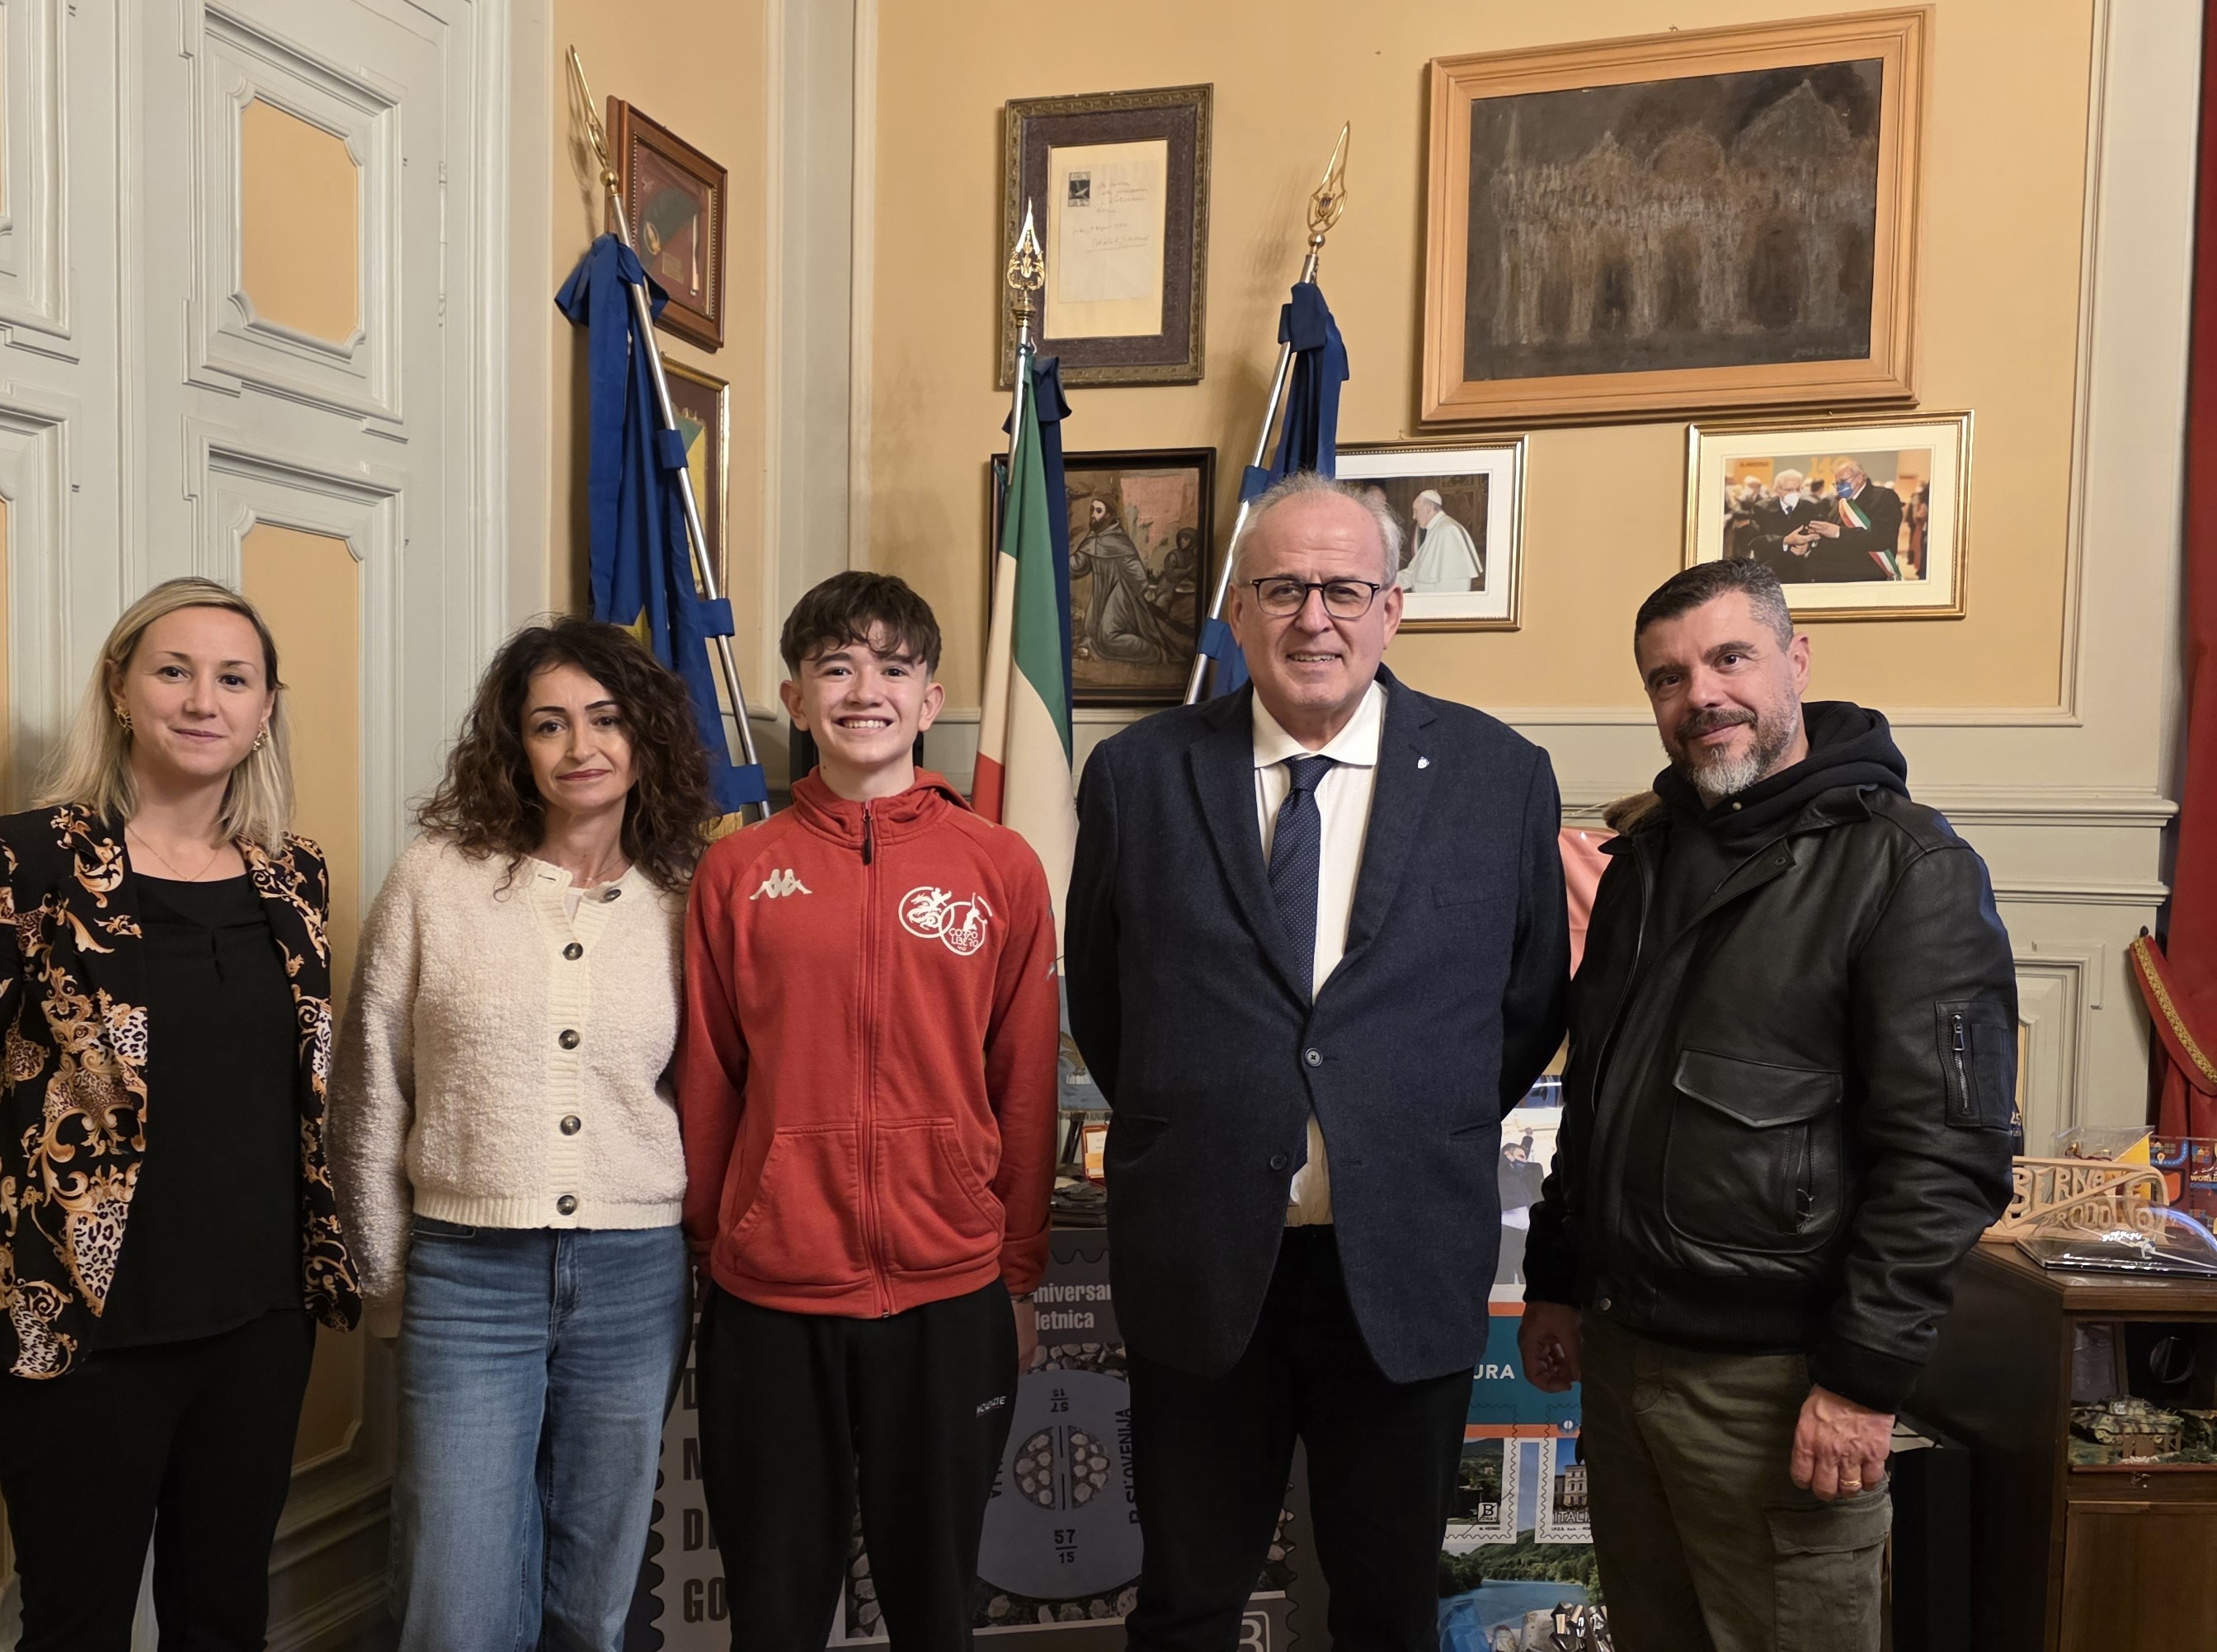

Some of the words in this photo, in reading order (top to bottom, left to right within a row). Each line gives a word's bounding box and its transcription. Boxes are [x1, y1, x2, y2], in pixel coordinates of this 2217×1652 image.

[1482, 1504, 1494, 1516] B
[1555, 1510, 1591, 1523] ITALI
[1054, 1529, 1076, 1544] 57
[1058, 1551, 1076, 1564] 15
